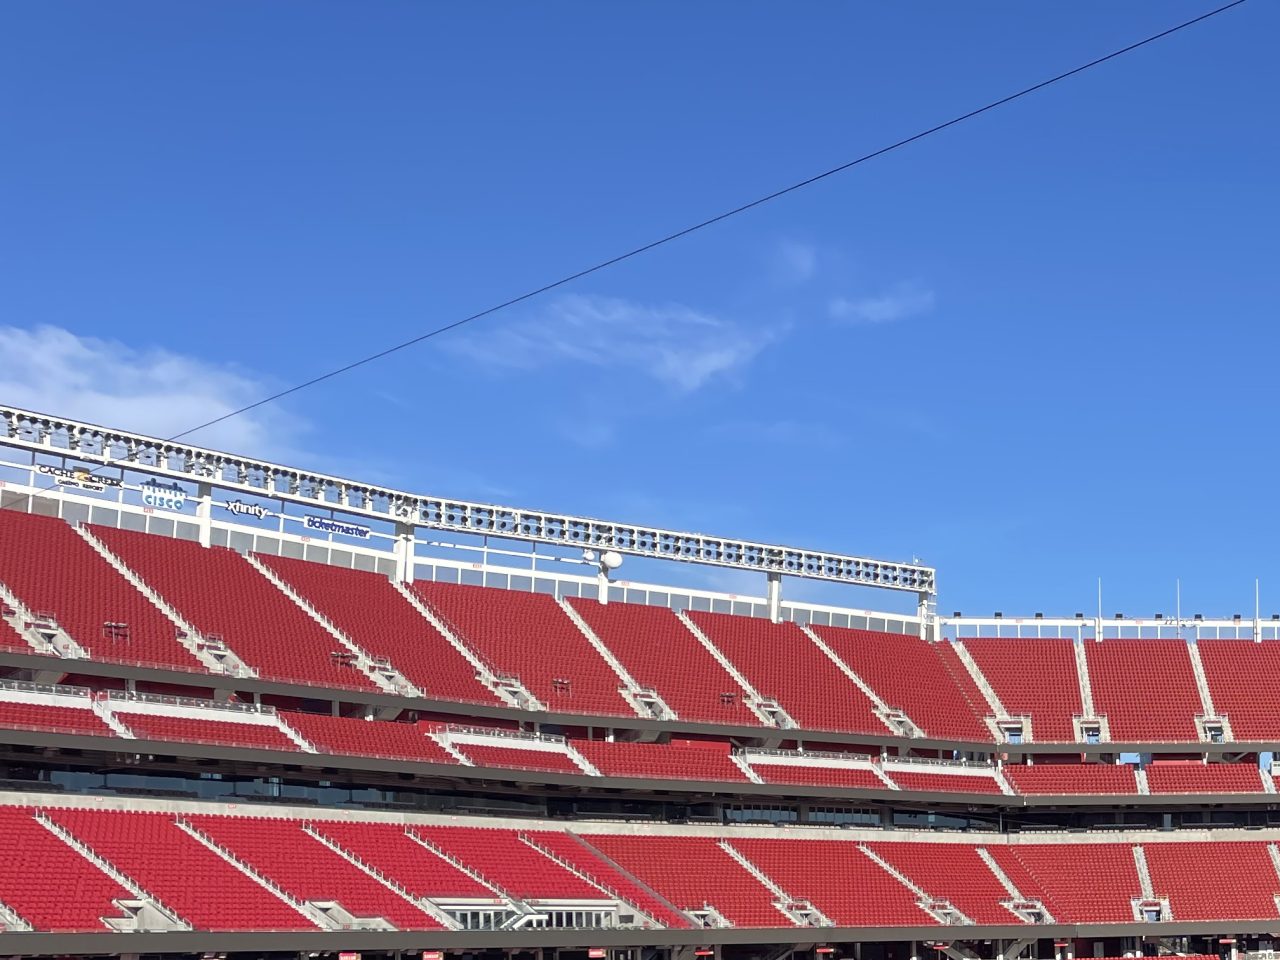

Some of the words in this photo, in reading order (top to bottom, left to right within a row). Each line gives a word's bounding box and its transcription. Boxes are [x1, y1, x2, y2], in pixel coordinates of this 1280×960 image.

[38, 465, 75, 479] CACHE
[88, 475, 123, 489] CREEK
[144, 494, 184, 511] CISCO
[225, 499, 269, 520] xfinity
[306, 516, 370, 538] ticketmaster
